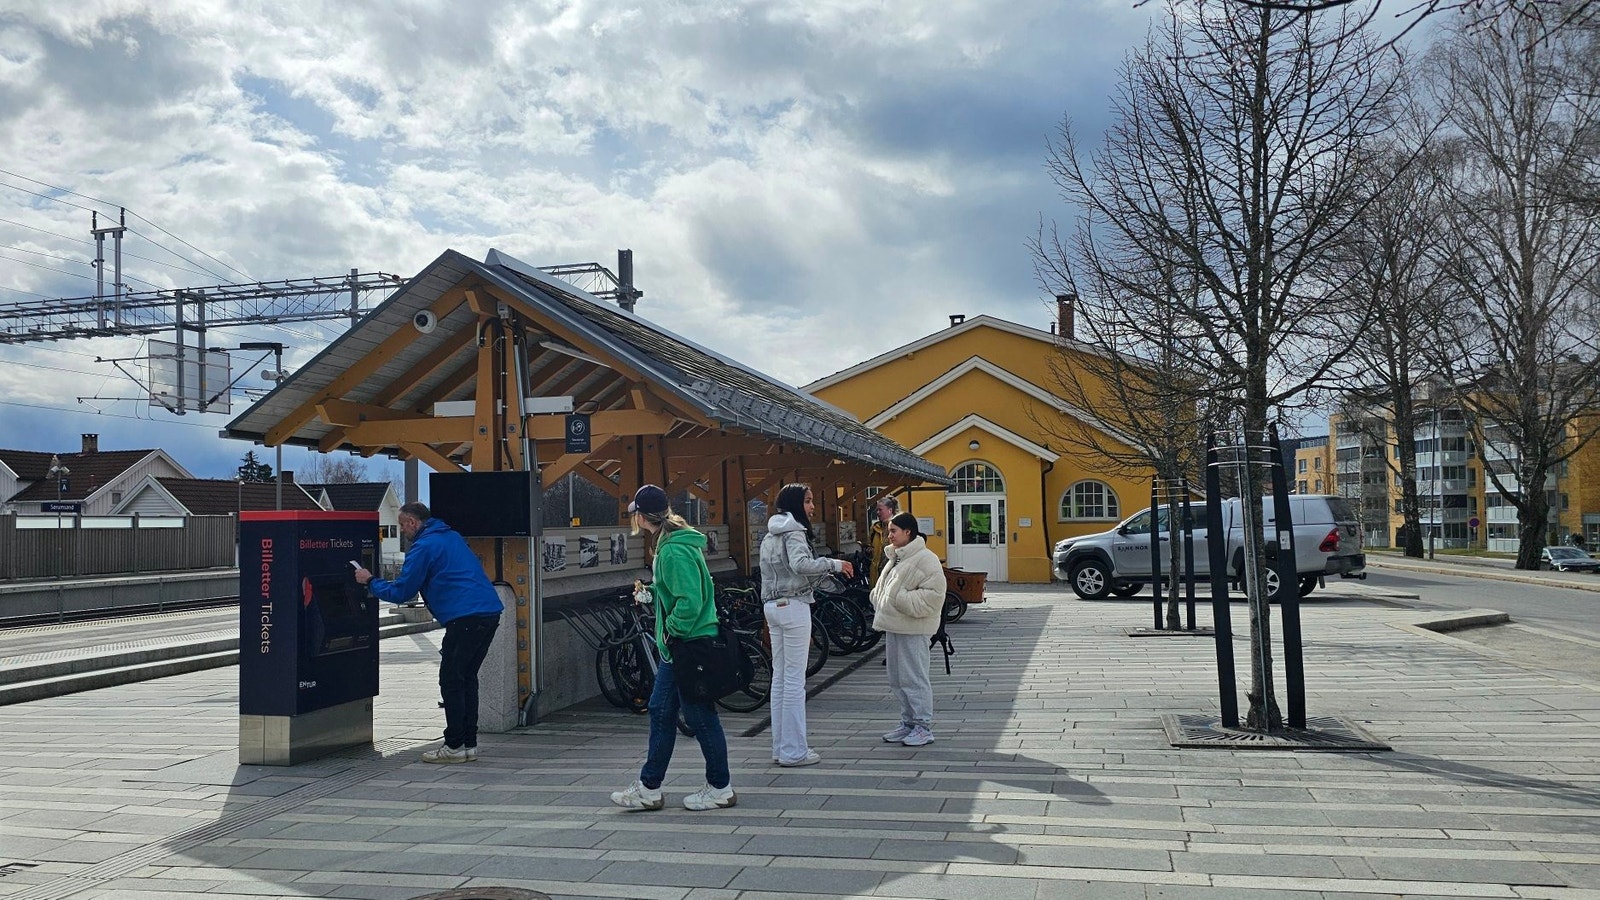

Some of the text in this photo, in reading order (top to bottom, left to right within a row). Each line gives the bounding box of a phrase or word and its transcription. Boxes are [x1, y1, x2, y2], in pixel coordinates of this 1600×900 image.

[300, 538, 354, 549] Billetter Tickets
[261, 539, 273, 654] Billetter Tickets
[299, 680, 317, 689] ENTUR
